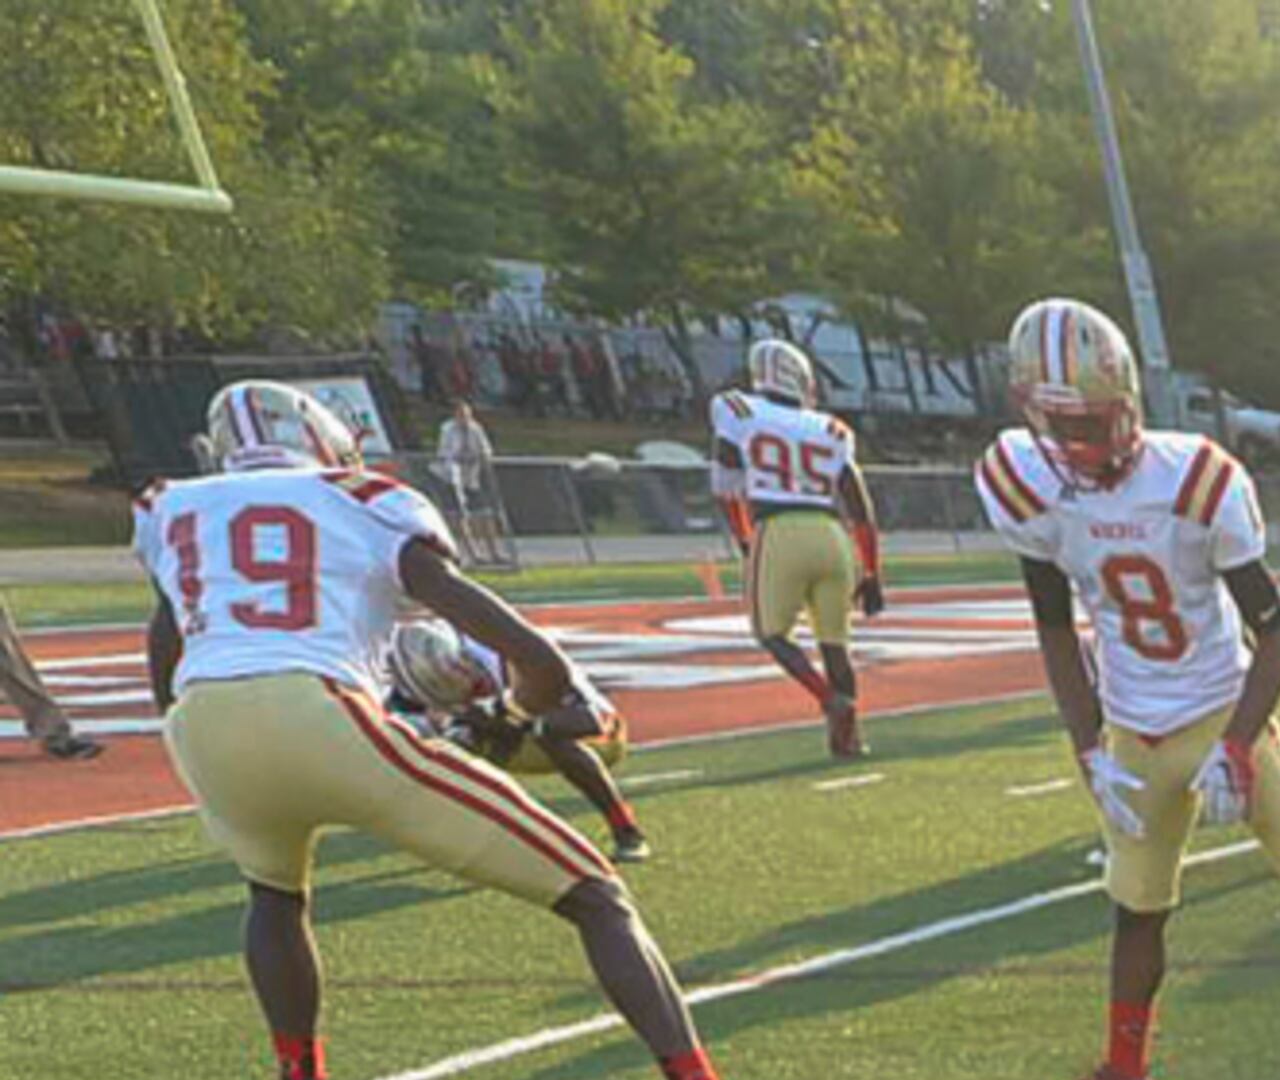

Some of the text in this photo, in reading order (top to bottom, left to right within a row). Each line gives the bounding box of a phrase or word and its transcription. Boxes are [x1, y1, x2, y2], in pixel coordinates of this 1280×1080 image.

[749, 431, 834, 496] 95
[167, 504, 320, 634] 19
[1101, 552, 1189, 664] 8
